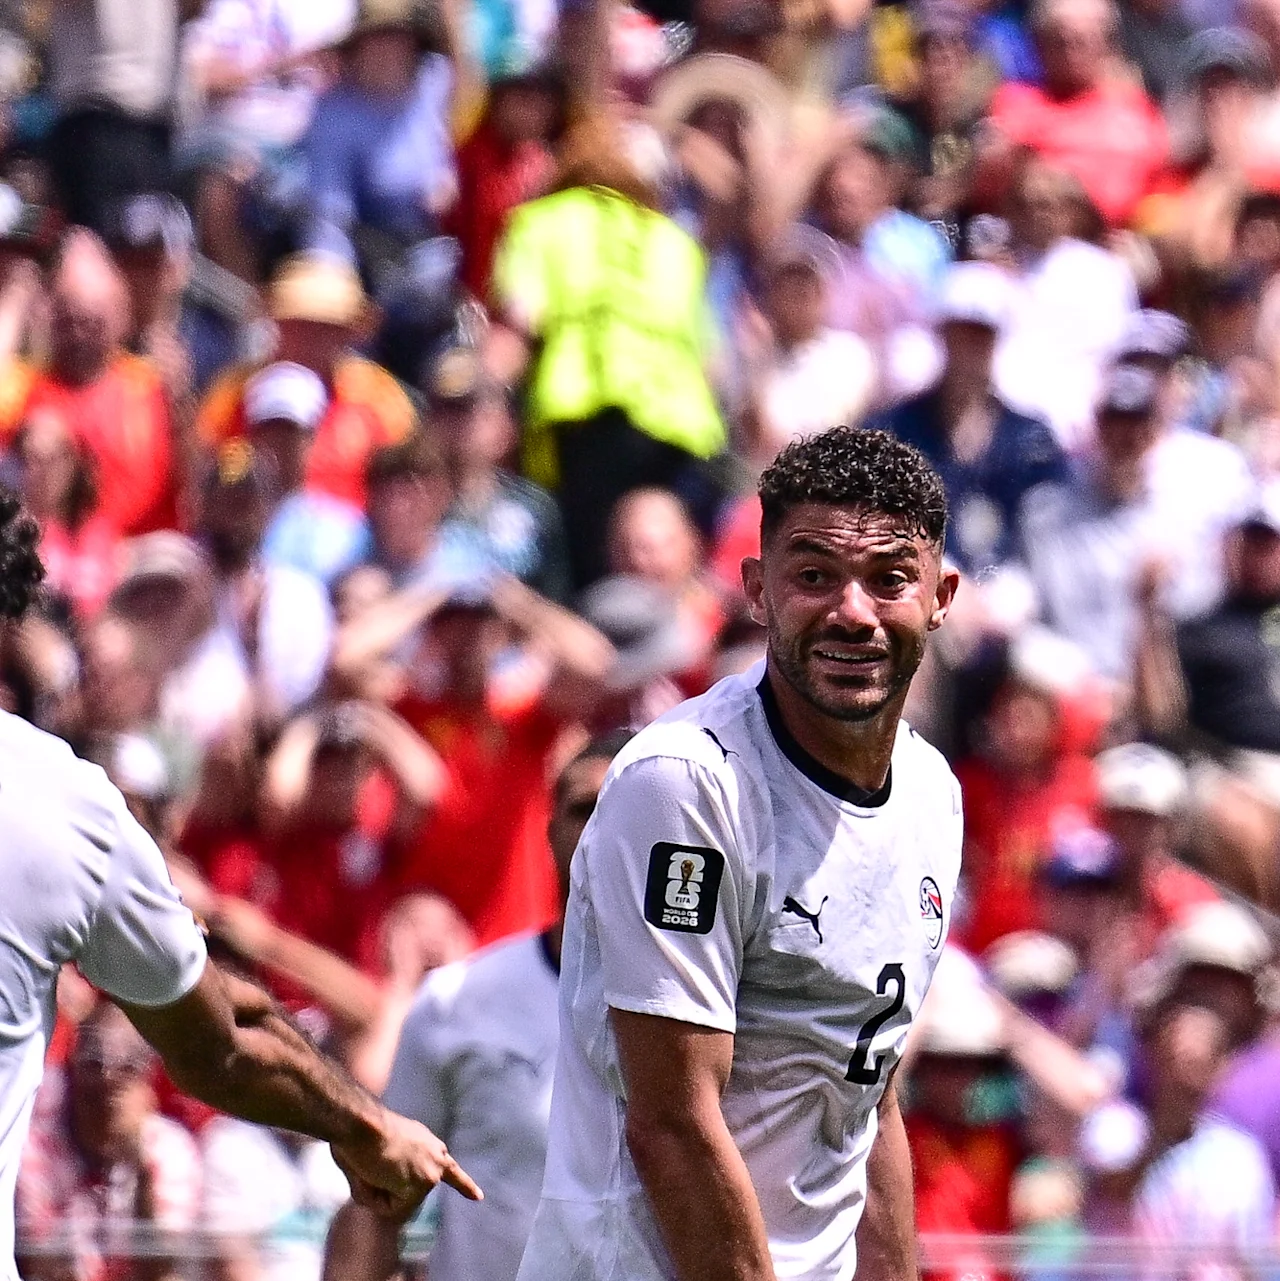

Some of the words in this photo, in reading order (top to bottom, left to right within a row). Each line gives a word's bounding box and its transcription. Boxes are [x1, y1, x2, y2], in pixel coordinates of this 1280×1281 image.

[675, 896, 691, 905] FIFA
[663, 908, 687, 916] WORLD
[661, 914, 699, 927] 2026
[844, 963, 907, 1085] 2
